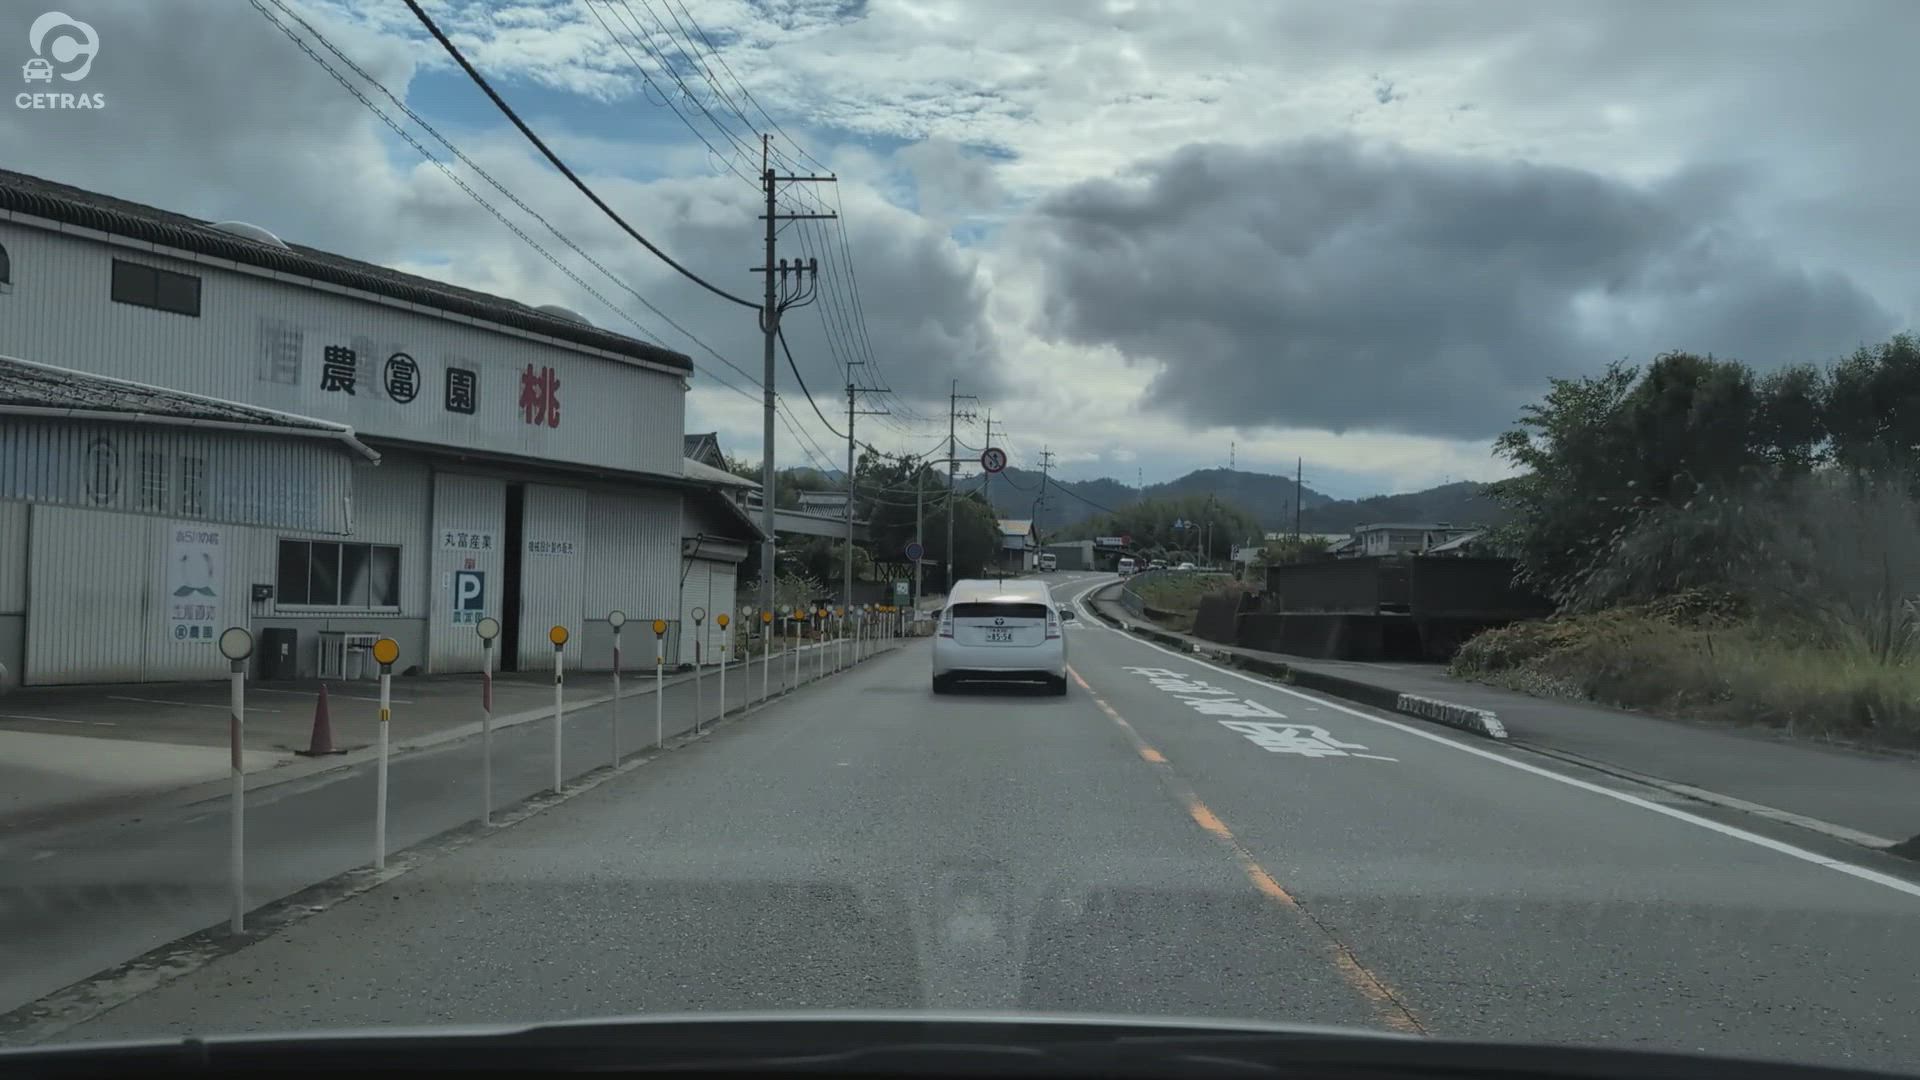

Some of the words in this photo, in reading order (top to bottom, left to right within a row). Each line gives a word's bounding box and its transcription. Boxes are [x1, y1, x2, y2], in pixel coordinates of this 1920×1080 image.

[519, 362, 560, 429] 桃
[444, 532, 493, 550] 丸富産業
[457, 574, 481, 610] P
